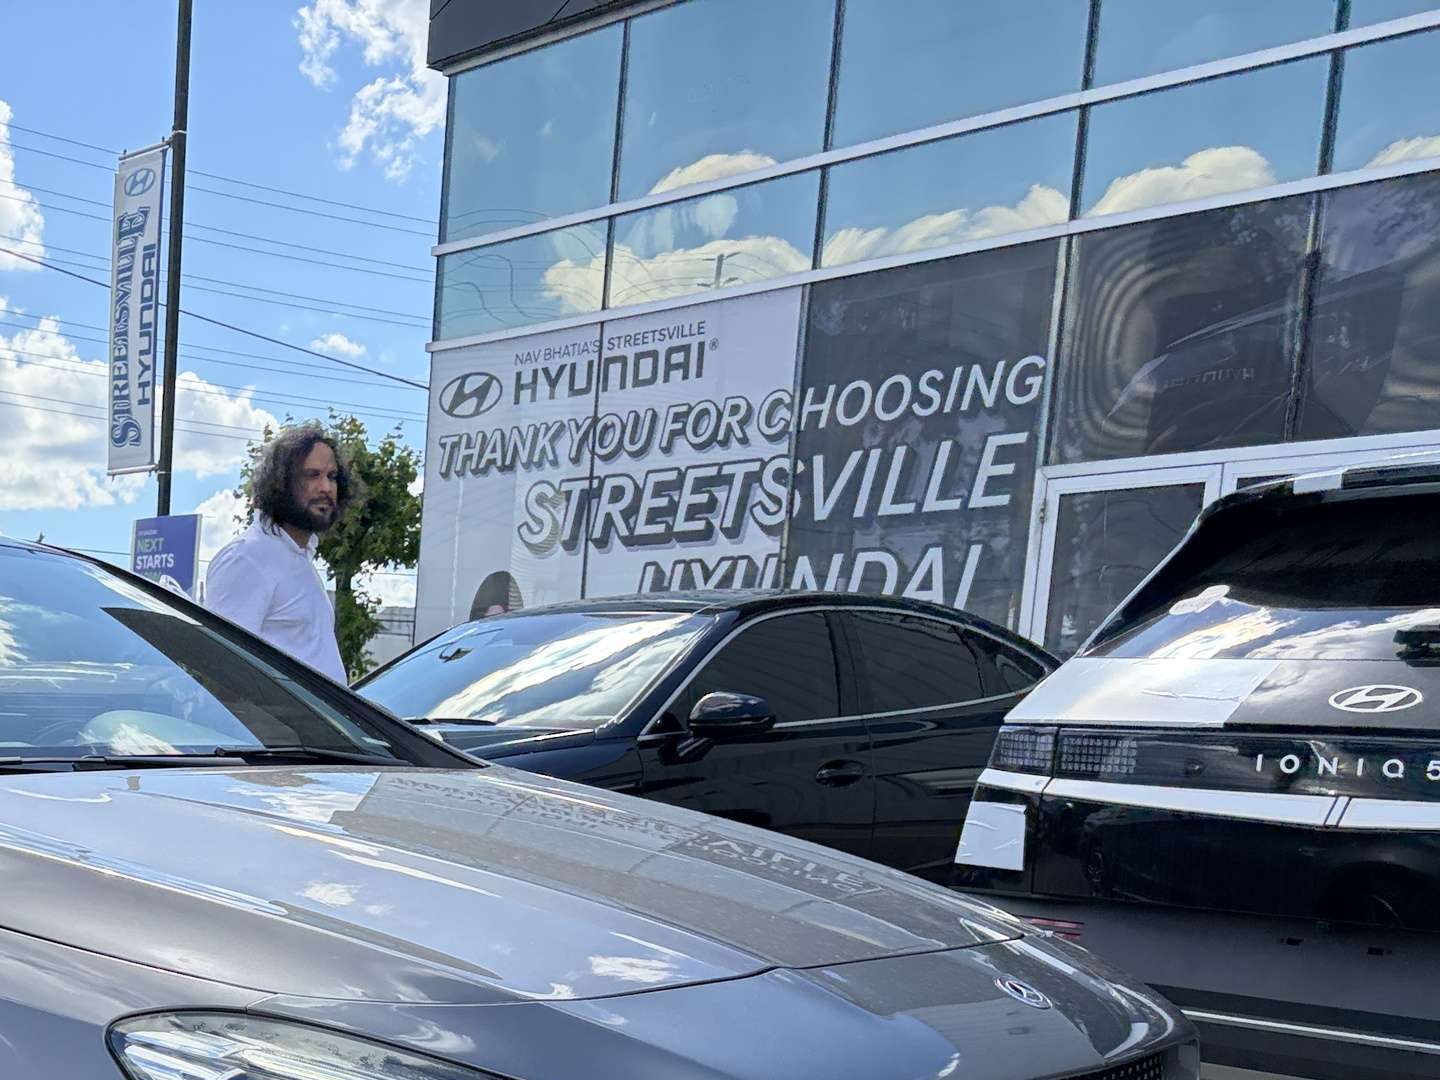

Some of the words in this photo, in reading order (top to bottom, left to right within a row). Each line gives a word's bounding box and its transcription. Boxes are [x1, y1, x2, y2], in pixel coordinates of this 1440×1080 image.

[111, 206, 151, 447] STREETSVILLE
[137, 243, 156, 405] HYUNDAI
[514, 350, 541, 366] NAV
[543, 339, 601, 361] BHATIA'S
[607, 321, 706, 351] STREETSVILLE
[438, 420, 565, 478] THANK
[568, 407, 657, 464] YOU
[659, 395, 751, 455] FOR
[757, 355, 1047, 442] CHOOSING
[517, 430, 1030, 552] STREETSVILLE
[135, 553, 175, 570] STARTS
[136, 537, 165, 553] NEXT
[1255, 754, 1405, 779] IONIQ
[1426, 760, 1440, 781] 5
